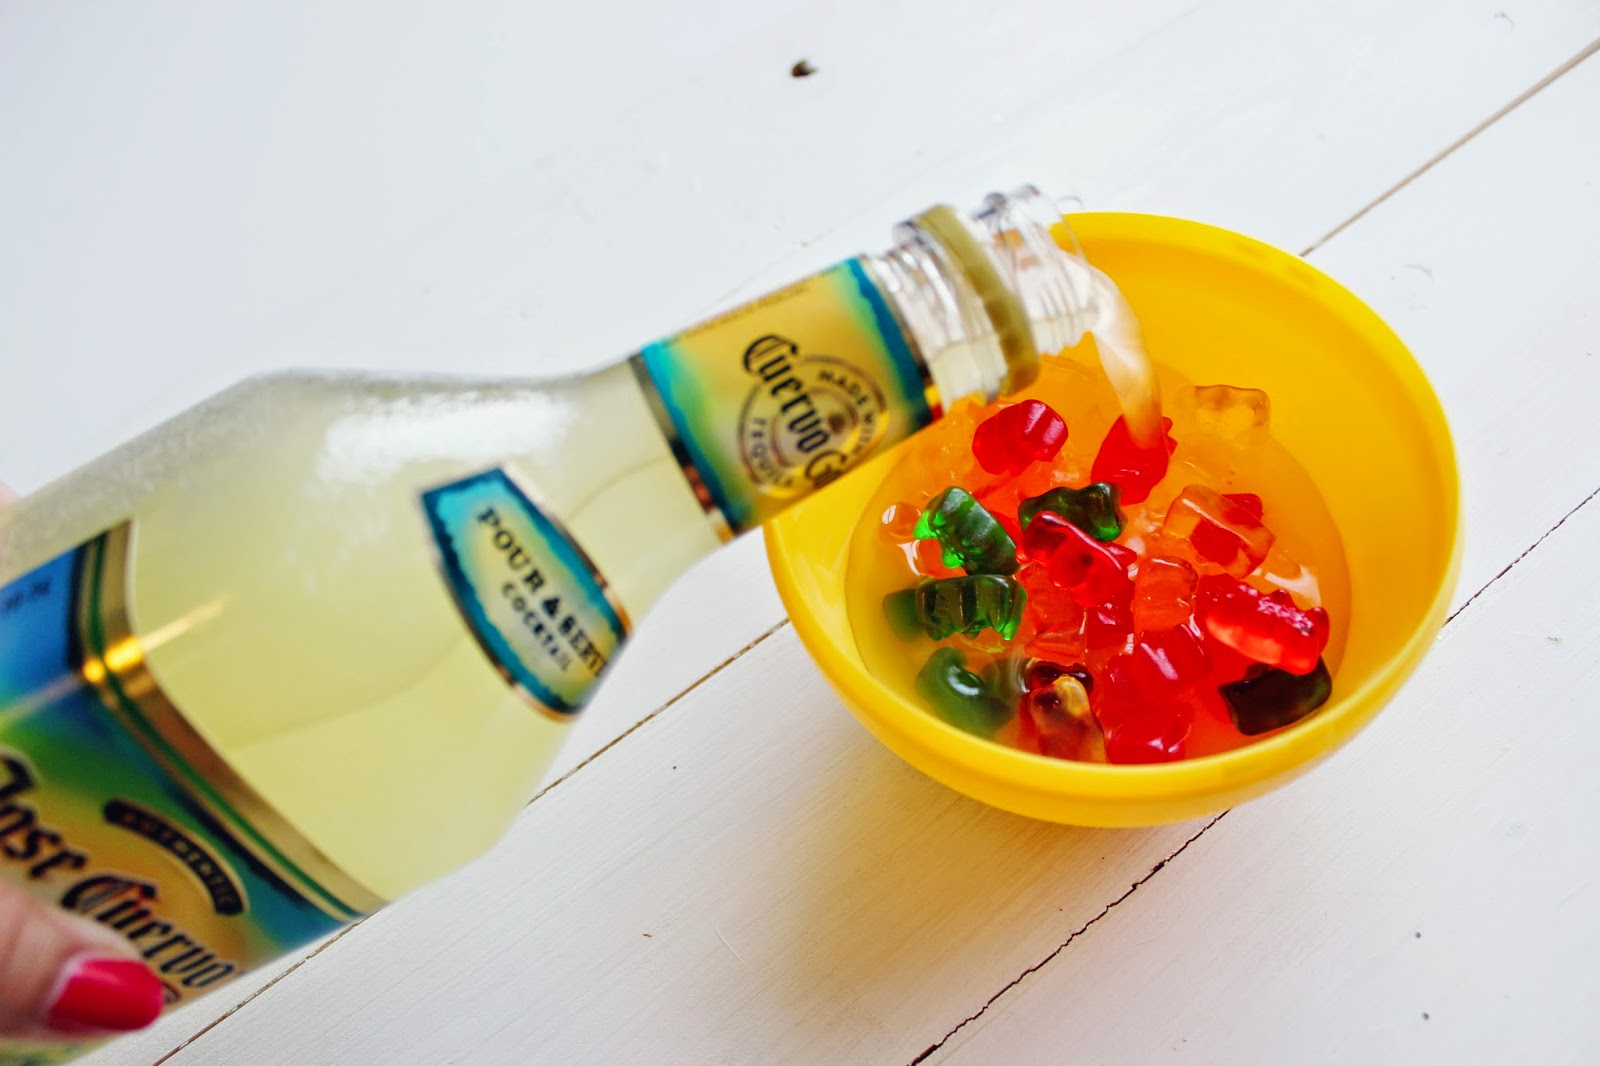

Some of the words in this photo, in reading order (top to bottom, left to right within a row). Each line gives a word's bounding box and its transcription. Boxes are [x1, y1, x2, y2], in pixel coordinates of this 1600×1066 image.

[742, 333, 831, 454] Cuervo
[818, 369, 869, 406] MADE
[476, 507, 546, 593] POUR
[542, 597, 561, 620] &
[558, 615, 608, 678] SERV
[502, 582, 573, 672] COCKTAIL
[61, 874, 236, 989] Cuervo
